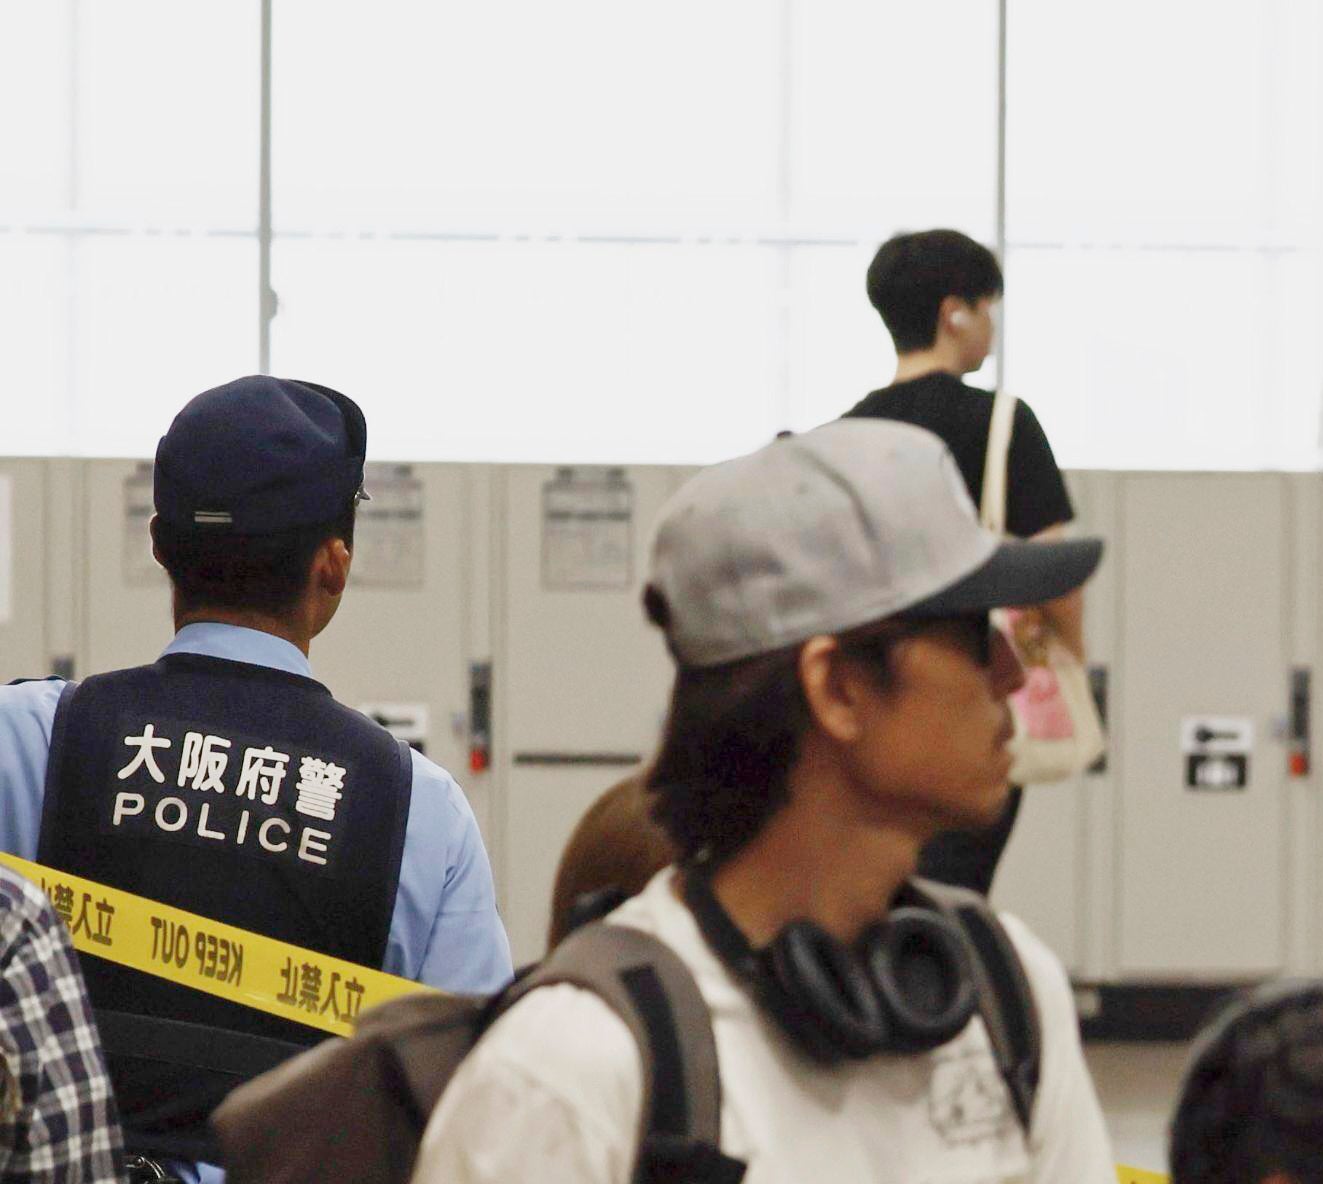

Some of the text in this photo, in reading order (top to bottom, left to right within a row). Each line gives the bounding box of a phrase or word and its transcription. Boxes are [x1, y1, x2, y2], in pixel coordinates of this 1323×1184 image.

[117, 723, 348, 821] 大阪府警
[112, 791, 333, 867] POLICE
